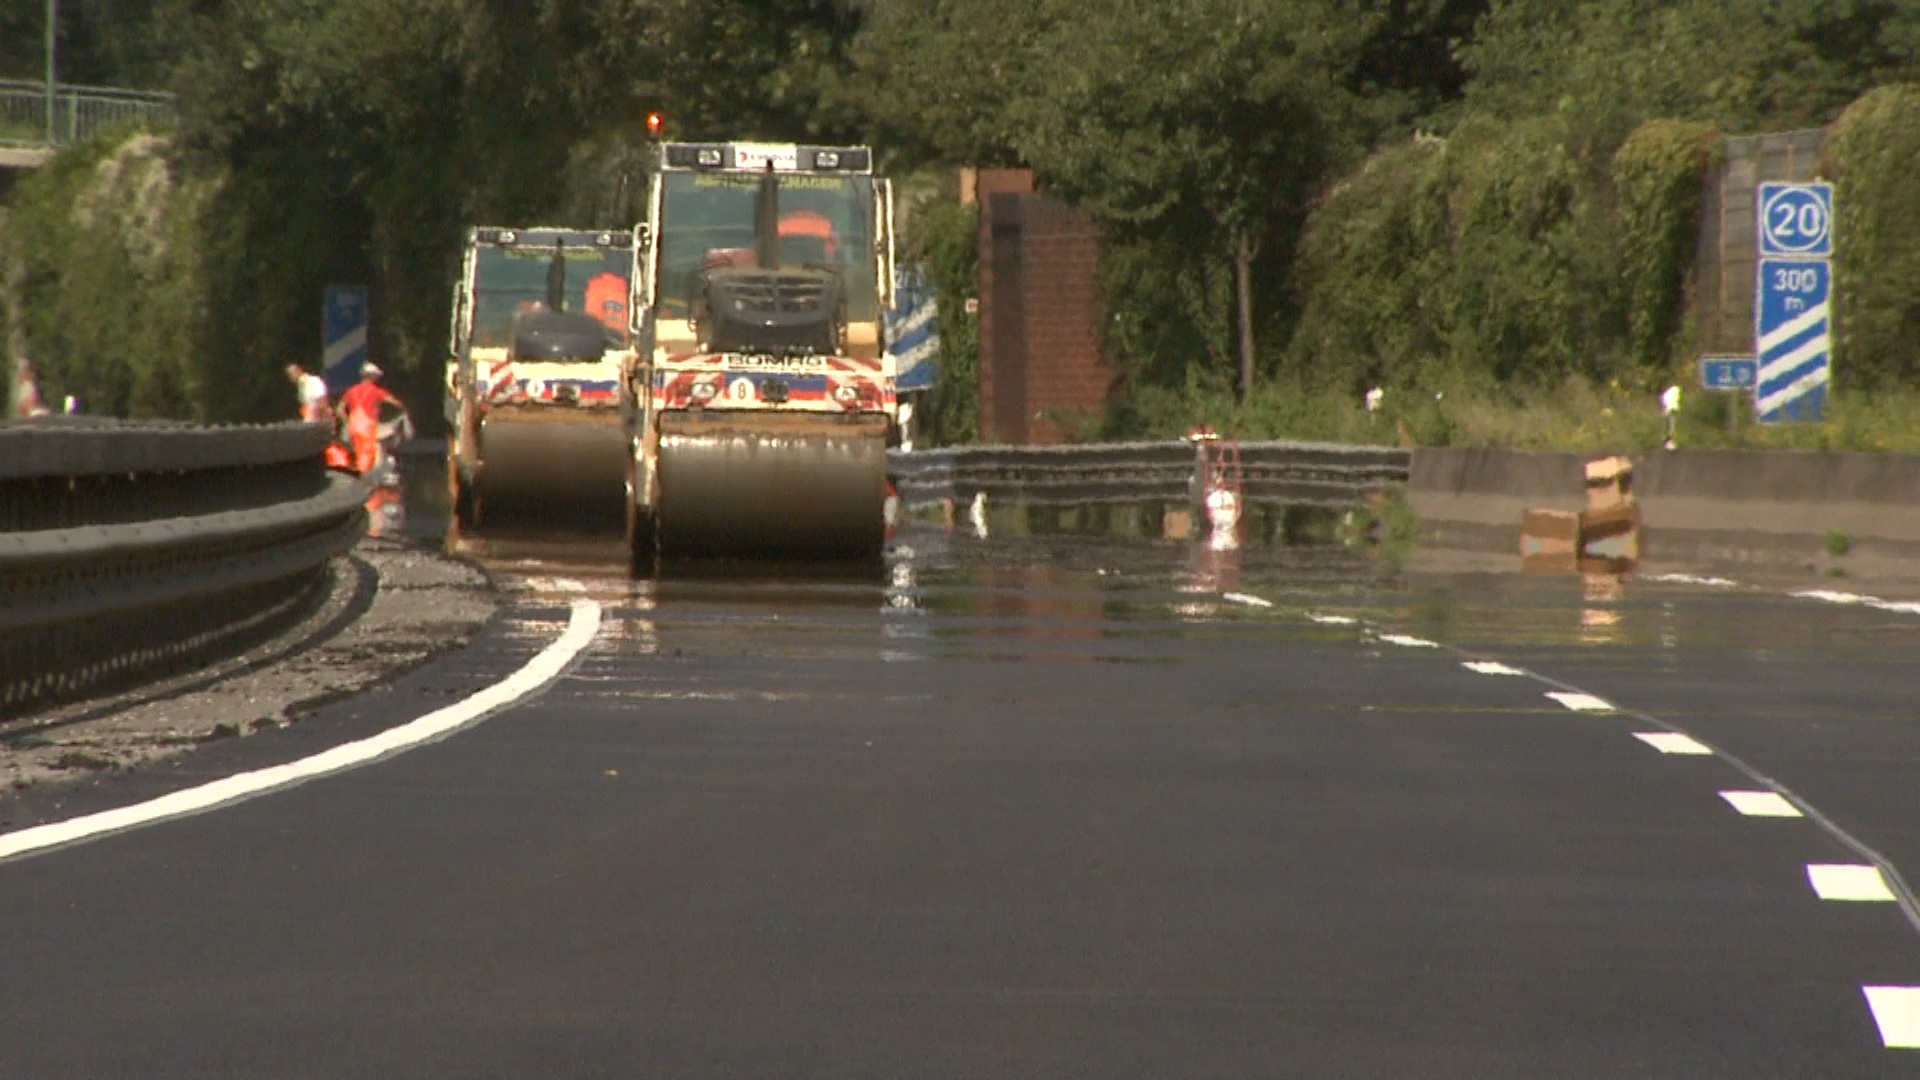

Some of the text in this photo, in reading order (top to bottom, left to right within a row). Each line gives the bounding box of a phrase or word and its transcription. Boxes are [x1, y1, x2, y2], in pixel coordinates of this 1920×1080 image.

[1772, 202, 1822, 237] 20
[1773, 268, 1818, 293] 300
[1784, 296, 1805, 312] m
